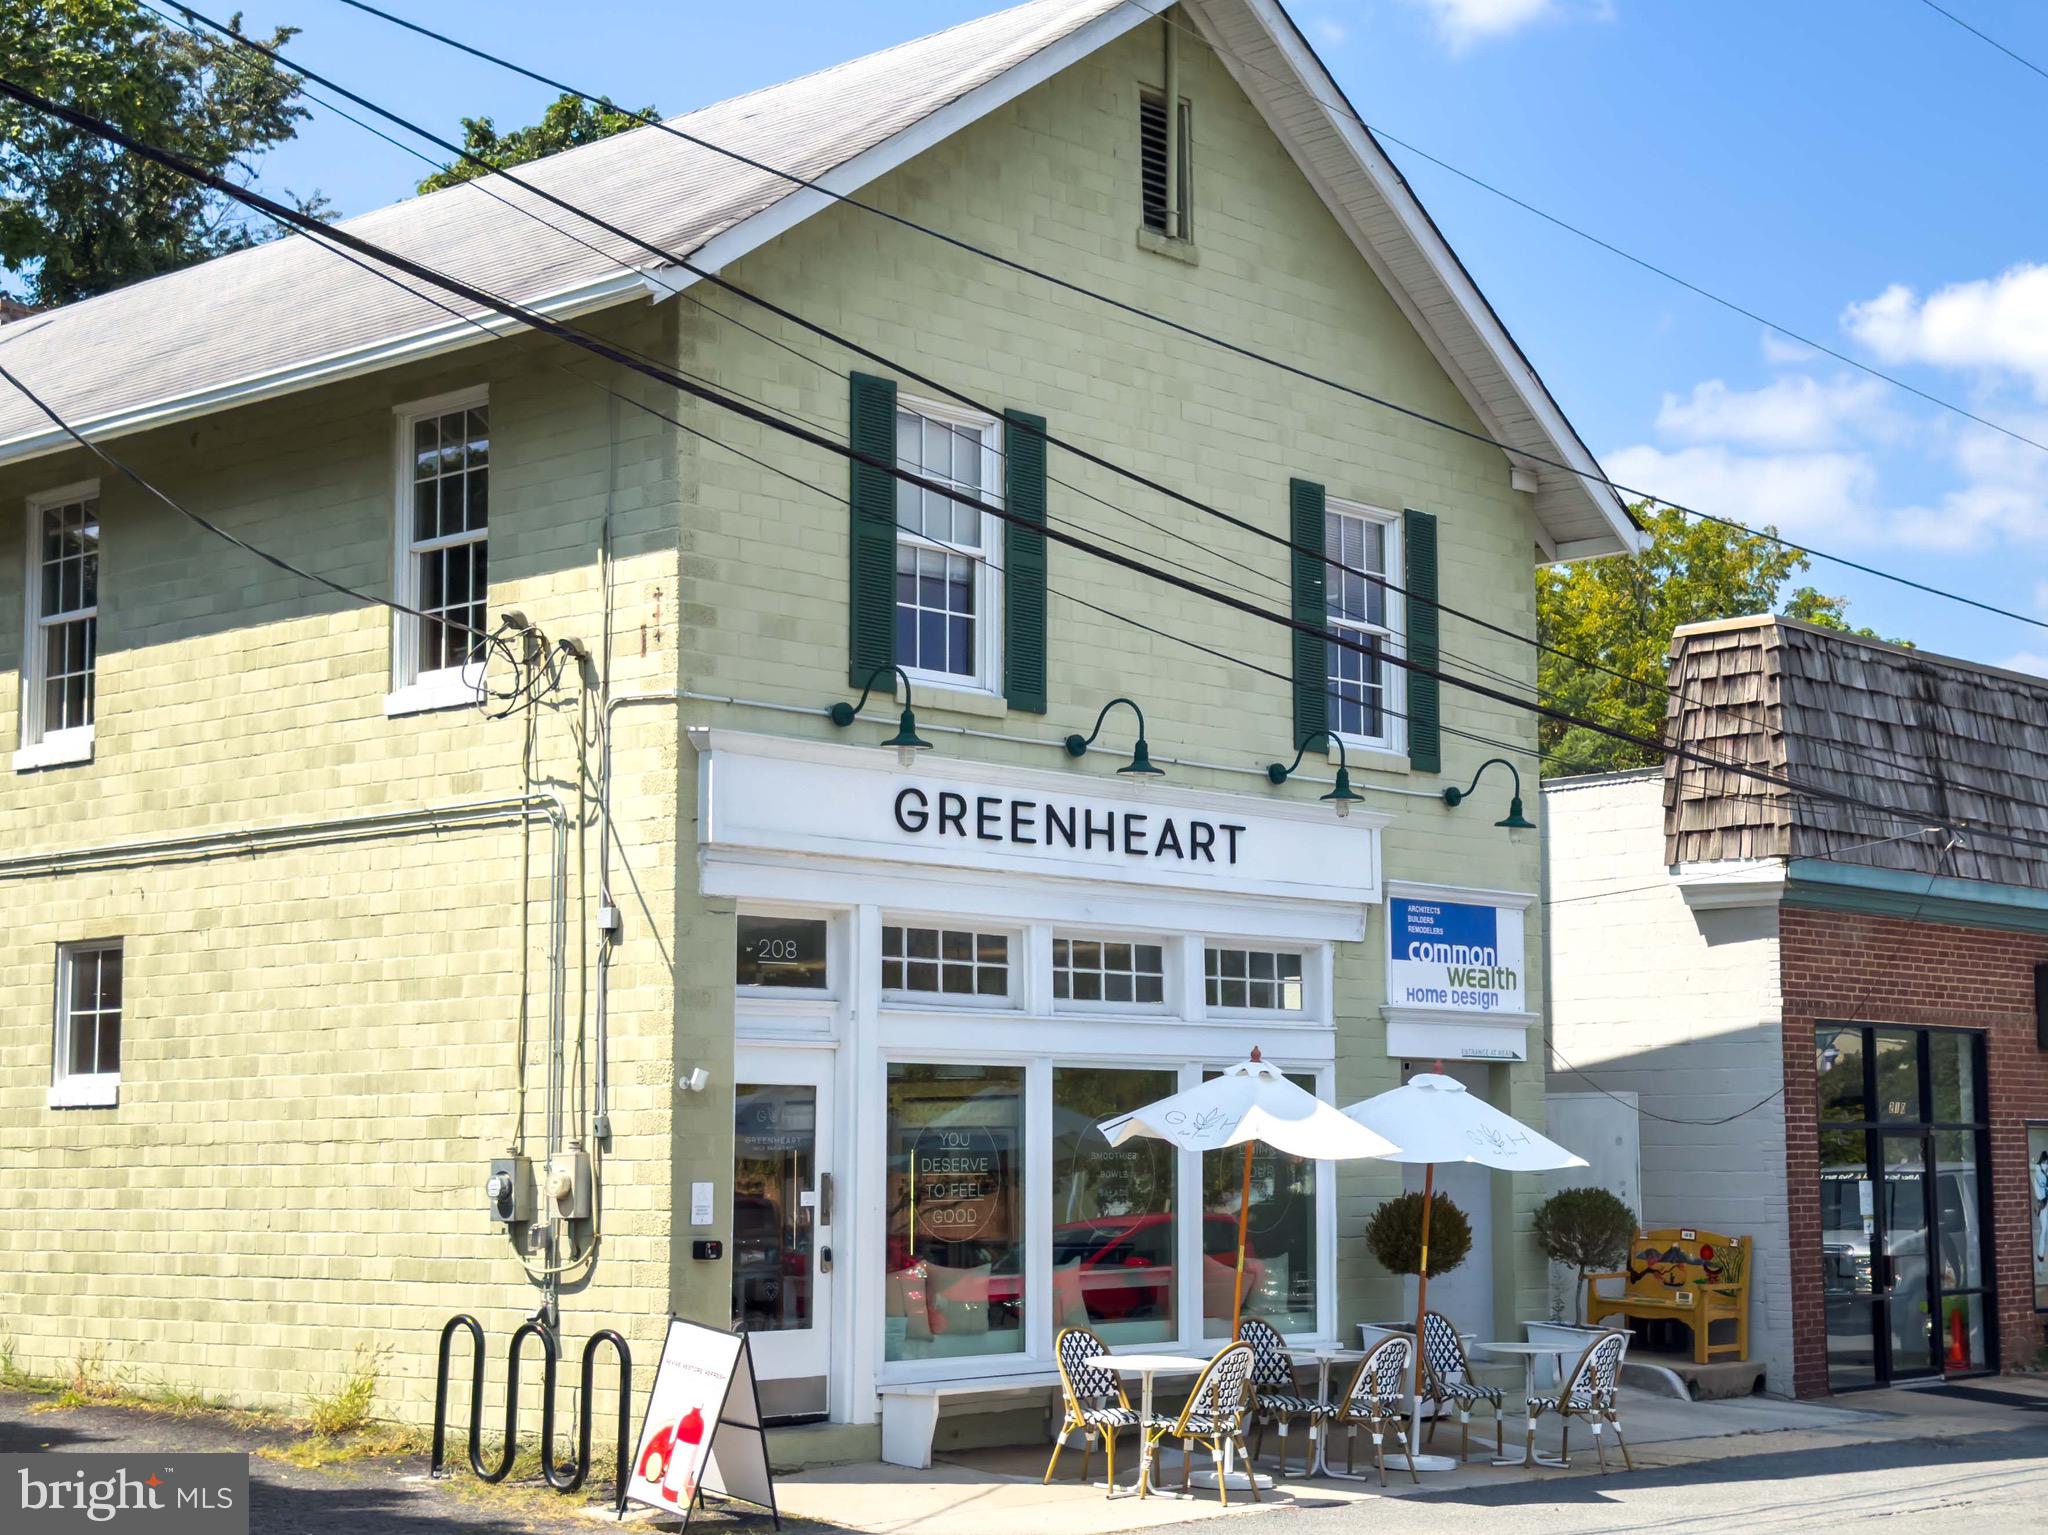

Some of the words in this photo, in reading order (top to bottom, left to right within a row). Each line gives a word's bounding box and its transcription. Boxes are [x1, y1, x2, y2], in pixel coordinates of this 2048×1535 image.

[894, 788, 1247, 865] GREENHEART
[1407, 904, 1441, 915] ARCHITECTS
[1407, 915, 1434, 924] BUILDERS
[1407, 925, 1444, 935] REMODELERS
[758, 938, 797, 959] 208
[1408, 941, 1498, 967] common
[1406, 987, 1448, 1004] Home
[1451, 990, 1499, 1009] Design
[939, 1132, 970, 1147] YOU
[921, 1157, 989, 1173] DESERVE
[926, 1183, 946, 1198] TO
[950, 1183, 985, 1198] FEEL
[932, 1208, 977, 1224] GOOD
